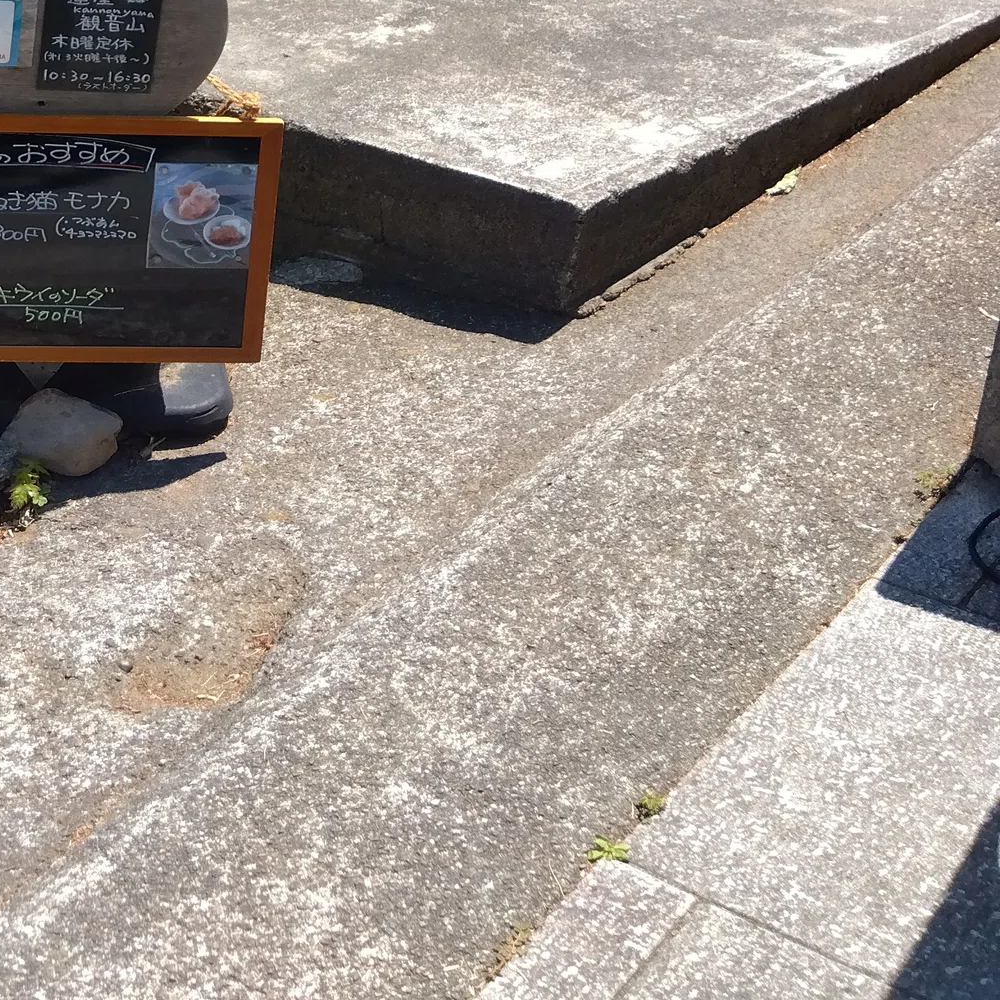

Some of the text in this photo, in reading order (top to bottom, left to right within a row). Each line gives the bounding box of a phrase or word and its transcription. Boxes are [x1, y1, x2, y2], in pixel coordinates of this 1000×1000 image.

[75, 14, 145, 33] 観音山
[24, 307, 83, 325] 500円
